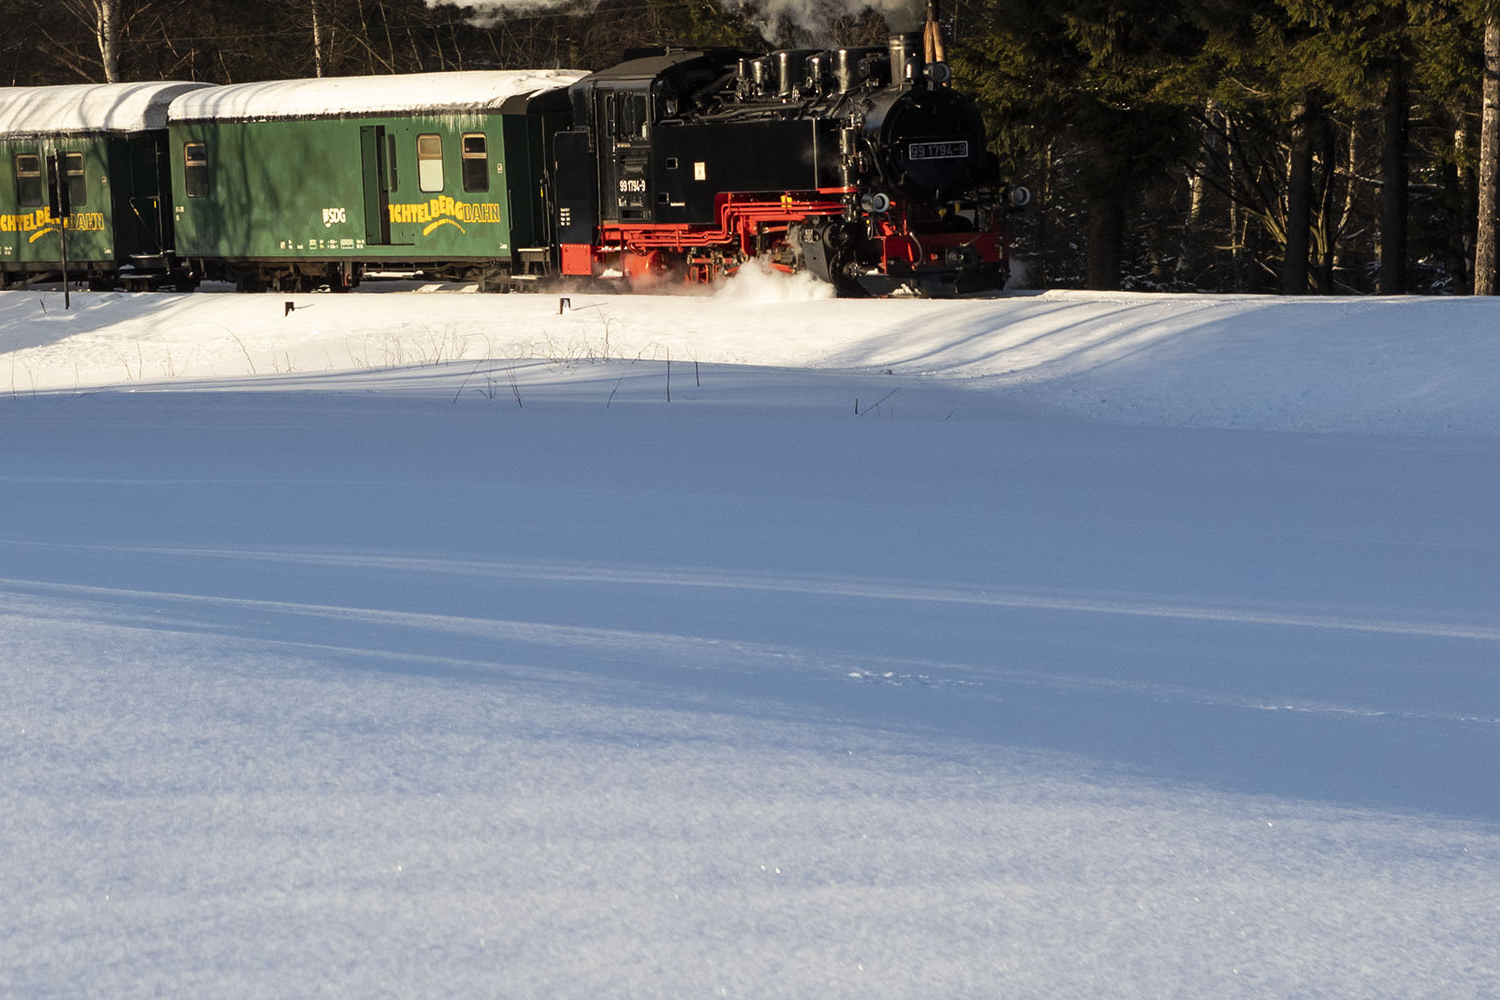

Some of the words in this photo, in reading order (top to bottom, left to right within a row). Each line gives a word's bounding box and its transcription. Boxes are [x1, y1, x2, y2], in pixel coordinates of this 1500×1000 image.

[911, 145, 925, 157] 99
[928, 143, 966, 156] 1794-9
[619, 180, 628, 192] 99
[329, 208, 346, 223] SDG
